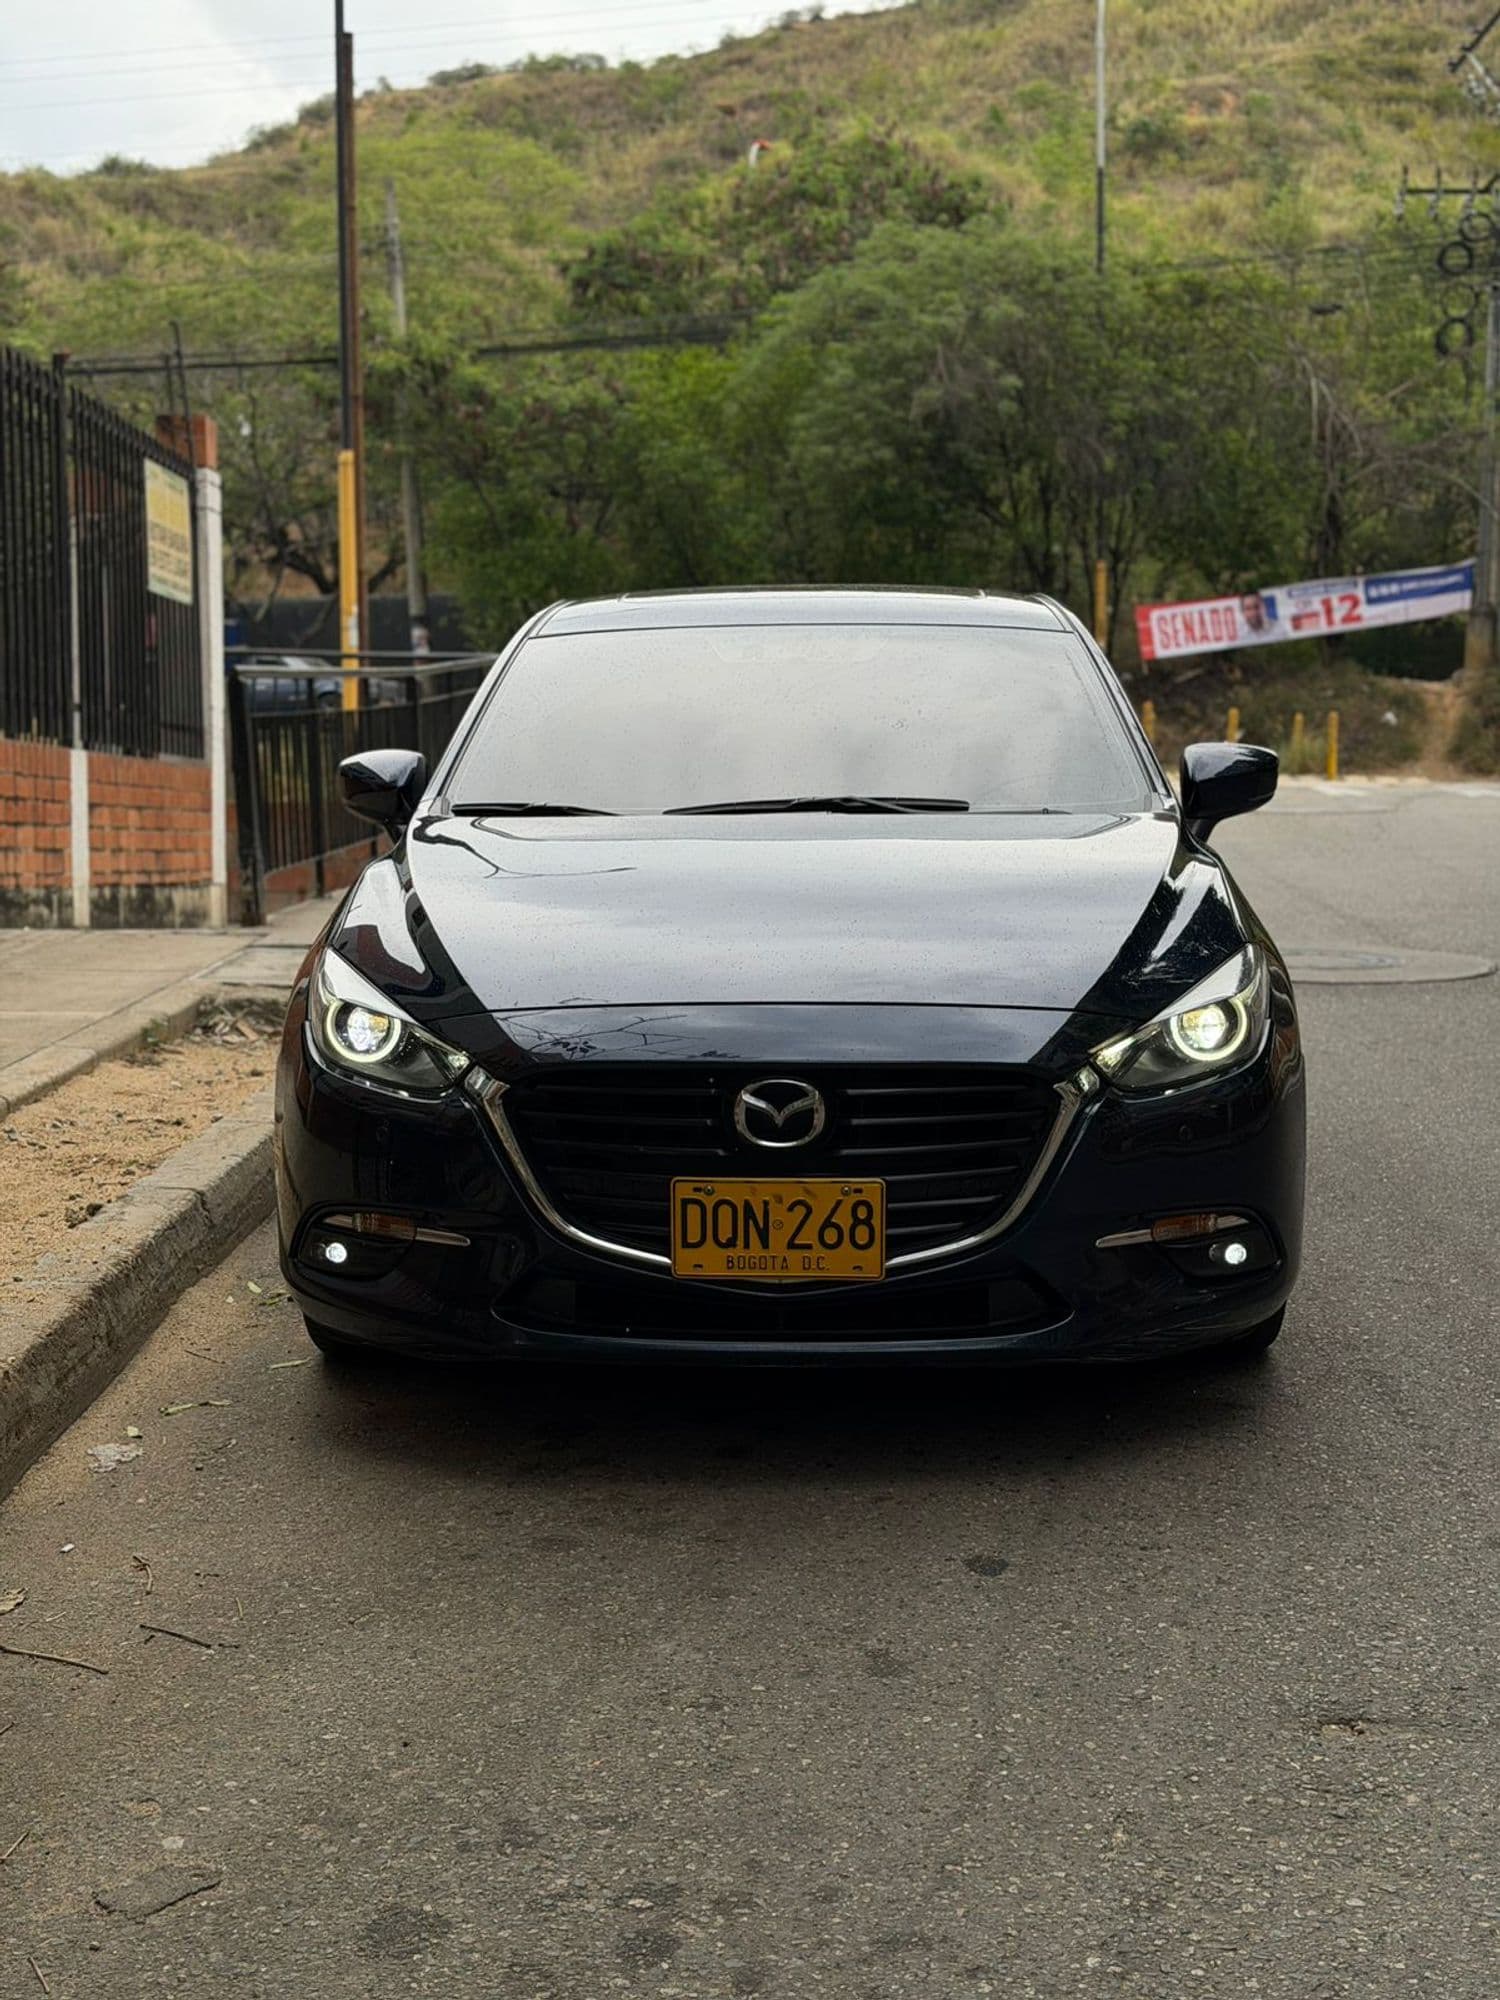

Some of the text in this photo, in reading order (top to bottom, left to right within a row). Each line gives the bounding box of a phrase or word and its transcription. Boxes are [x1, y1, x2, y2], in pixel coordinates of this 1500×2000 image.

[1157, 606, 1238, 650] SENADO
[1321, 593, 1363, 627] 12
[680, 1198, 876, 1250] DQN 268
[726, 1254, 789, 1271] BOGOTA
